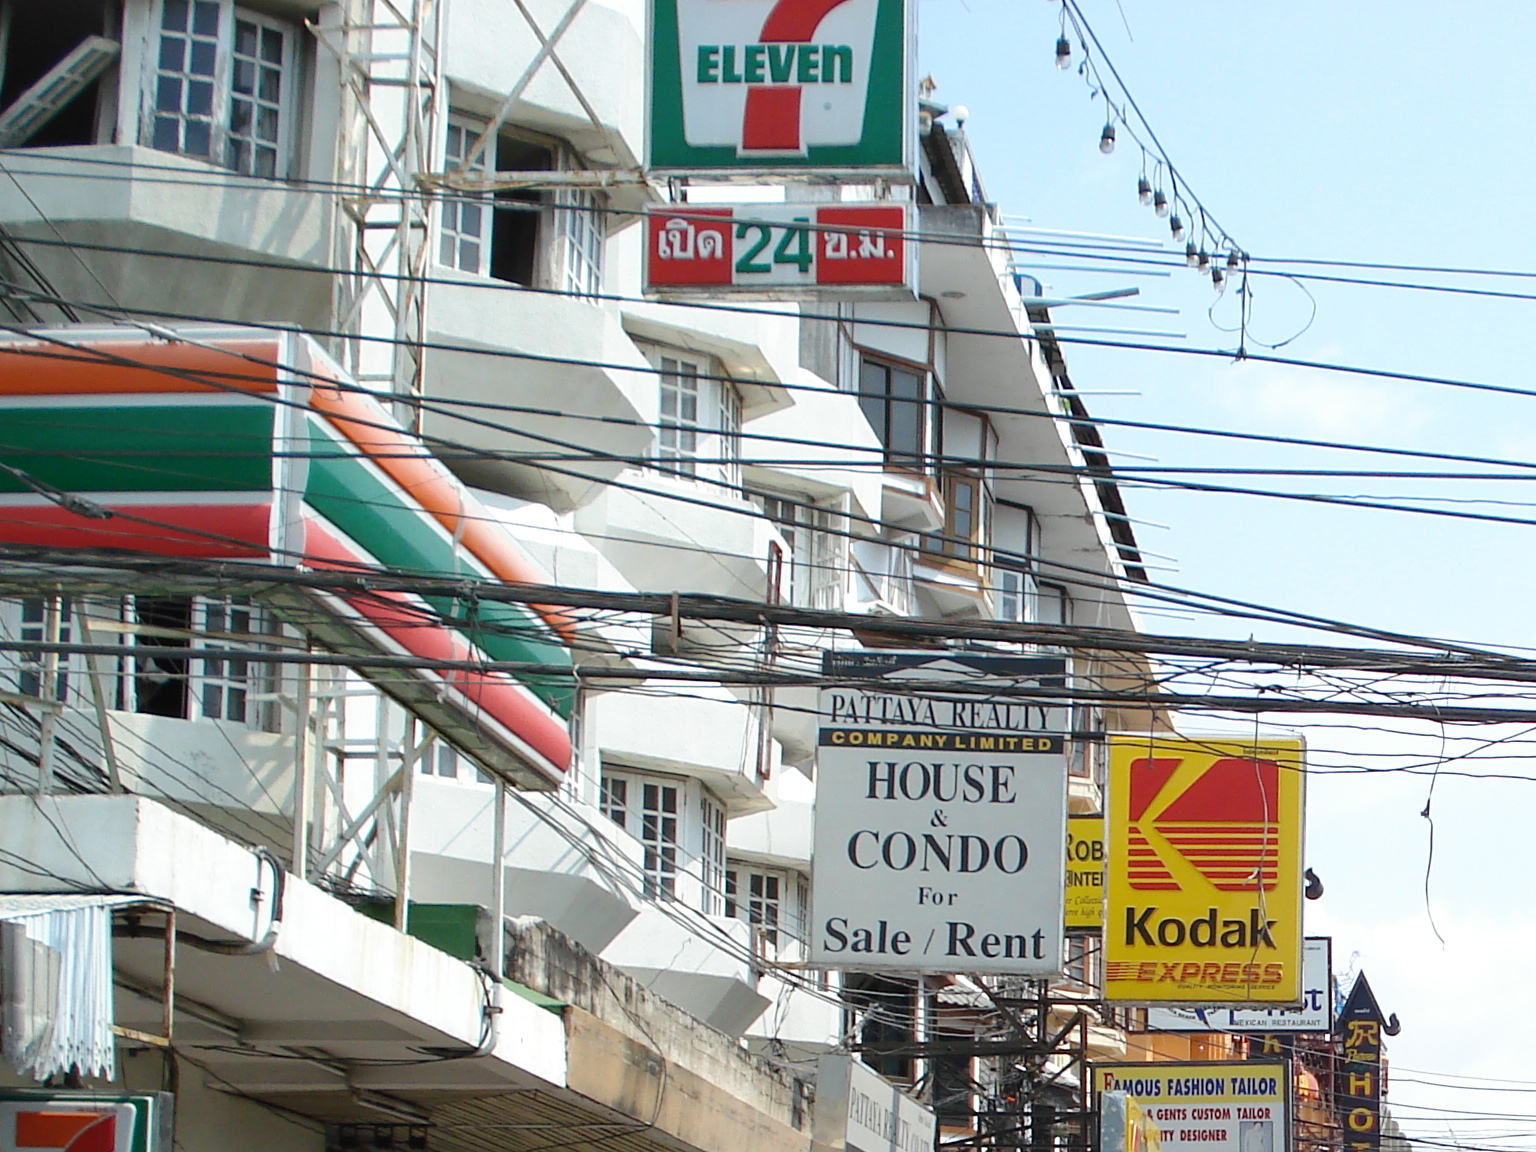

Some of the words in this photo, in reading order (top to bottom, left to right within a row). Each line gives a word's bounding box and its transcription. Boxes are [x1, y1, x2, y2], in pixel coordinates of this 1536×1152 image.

[658, 217, 724, 260] เปิด
[735, 216, 813, 274] 24
[831, 693, 937, 727] PATTAYA
[952, 700, 1051, 731] REALTY
[831, 730, 948, 747] COMPANY
[955, 735, 1052, 751] LIMITED
[865, 760, 1018, 804] HOUSE
[930, 808, 948, 828] &
[847, 829, 1029, 875] CONDO
[917, 886, 959, 907] For
[823, 916, 912, 956] Sale
[945, 921, 1046, 960] Rent
[1125, 905, 1280, 950] Kodak
[1136, 961, 1284, 984] EXPRESS
[1234, 1019, 1267, 1027] MEXICAN
[1271, 1019, 1322, 1027] RESTAURANT
[1168, 1078, 1225, 1097] FASHION
[1231, 1077, 1278, 1096] TAILOR
[1157, 1108, 1187, 1121] GENTS
[1191, 1108, 1231, 1121] CUSTOM
[1236, 1107, 1272, 1120] TAILOR
[1180, 1129, 1228, 1142] DESIGNER
